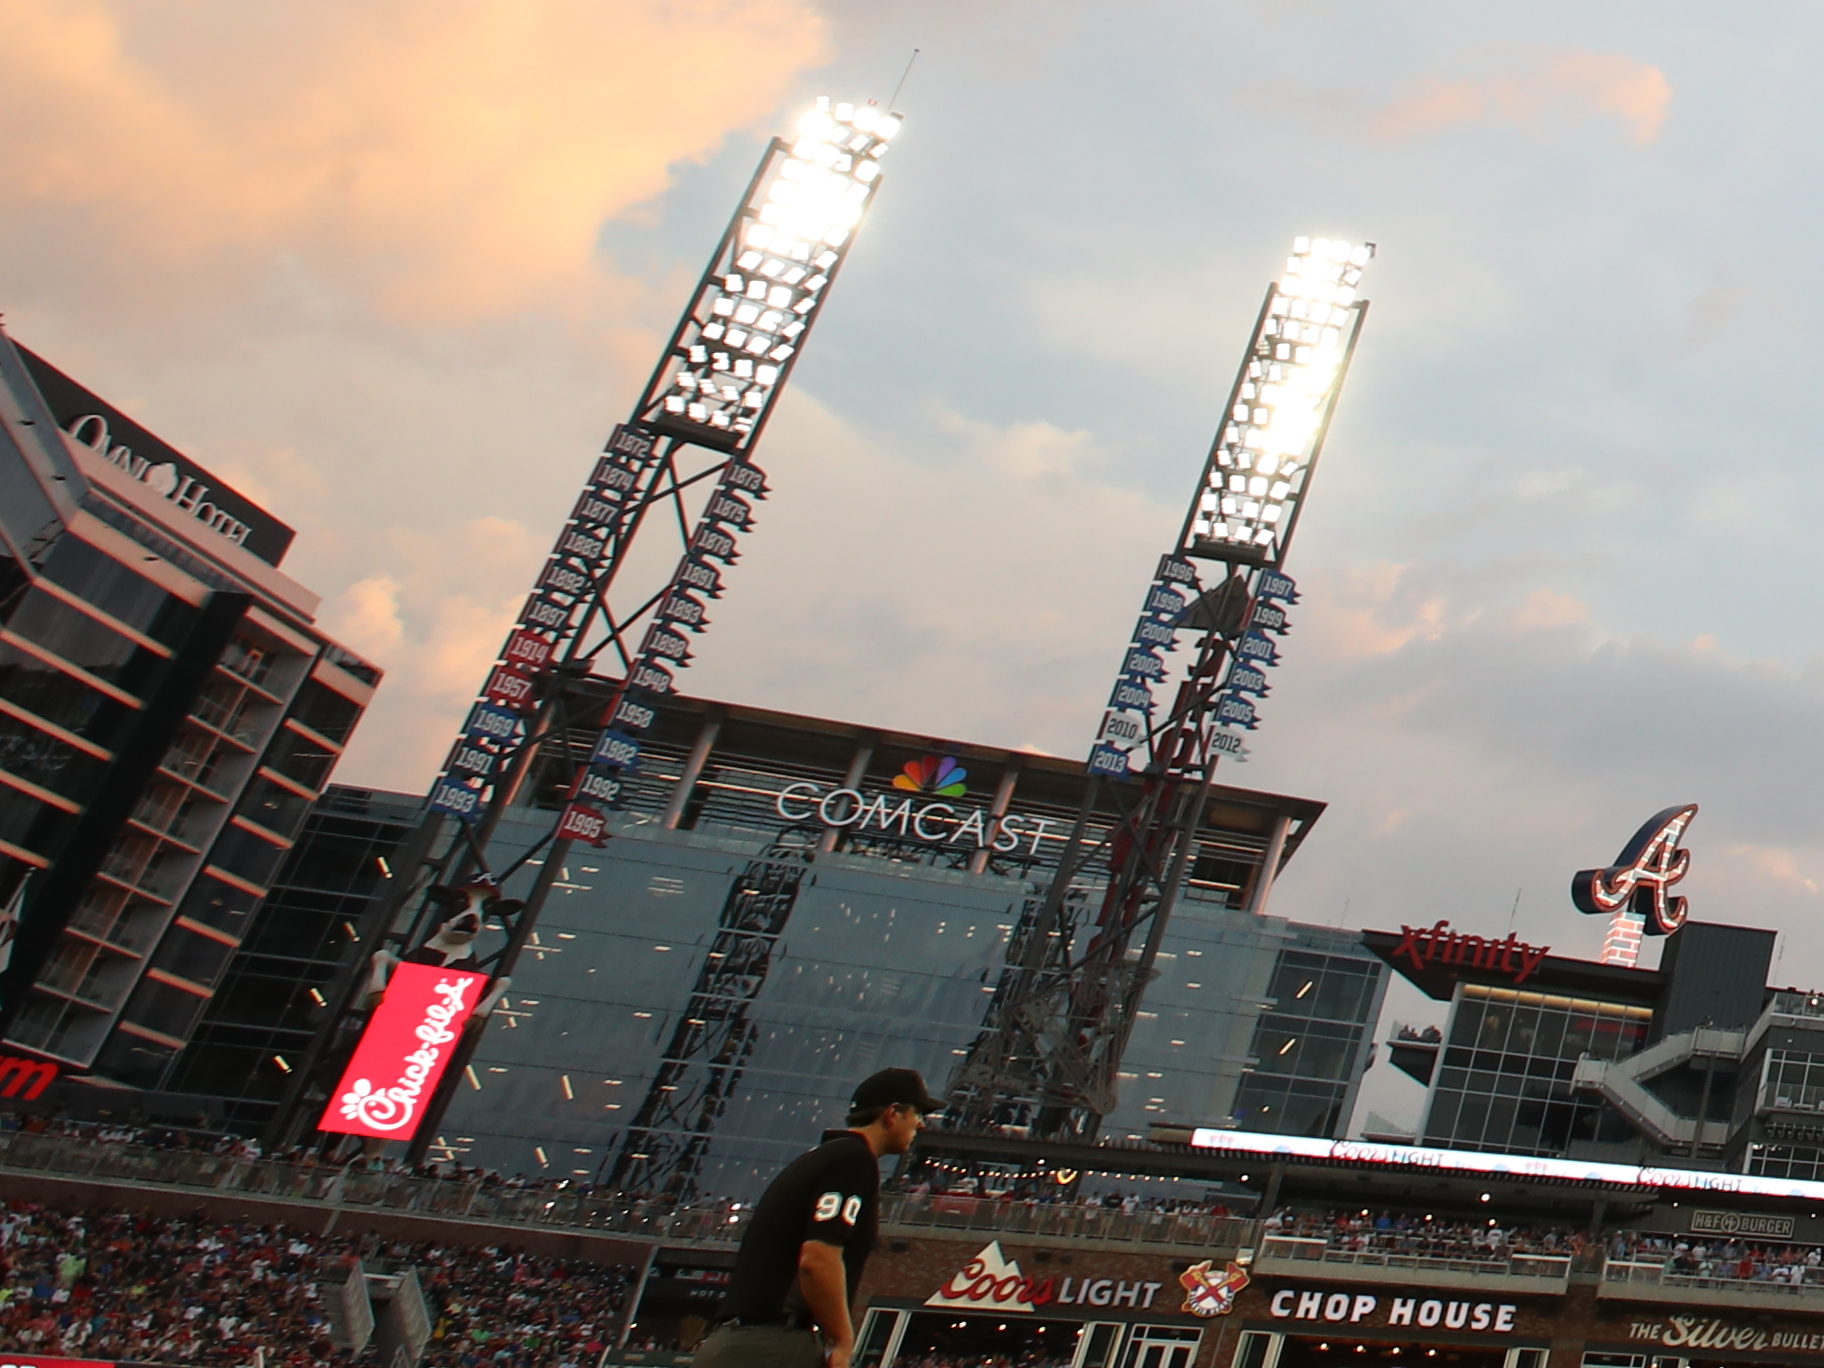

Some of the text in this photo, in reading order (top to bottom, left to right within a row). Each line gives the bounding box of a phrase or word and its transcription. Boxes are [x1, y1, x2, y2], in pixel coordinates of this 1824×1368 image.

[1163, 560, 1194, 581] 1996
[1263, 575, 1293, 597] 1997
[1253, 606, 1283, 628] 1999
[1141, 623, 1172, 644] 2000
[511, 636, 549, 663] 1914
[1243, 637, 1272, 659] 2001
[1129, 654, 1162, 675] 2002
[493, 673, 532, 699] 1957
[1232, 668, 1264, 689] 2003
[1118, 686, 1150, 708] 2004
[1222, 700, 1253, 721] 2005
[1107, 718, 1138, 739] 2010
[600, 738, 637, 765] 1982
[1211, 732, 1241, 754] 2012
[455, 748, 494, 775] 1991
[1094, 751, 1127, 772] 2013
[435, 785, 477, 812] 1993
[582, 774, 621, 801] 1992
[564, 811, 604, 838] 1995
[776, 782, 1057, 855] COMCAST
[1393, 919, 1550, 984] xfinity
[350, 977, 474, 1130] Chick-fil-A
[814, 1192, 861, 1226] 90
[1741, 1218, 1791, 1234] BURGER
[941, 1258, 1053, 1306] Coors
[1057, 1276, 1163, 1310] LIGHT
[1270, 1290, 1377, 1323] CHOP
[1387, 1297, 1517, 1332] HOUSE
[1629, 1322, 1662, 1340] THE
[1662, 1313, 1768, 1351] Silver
